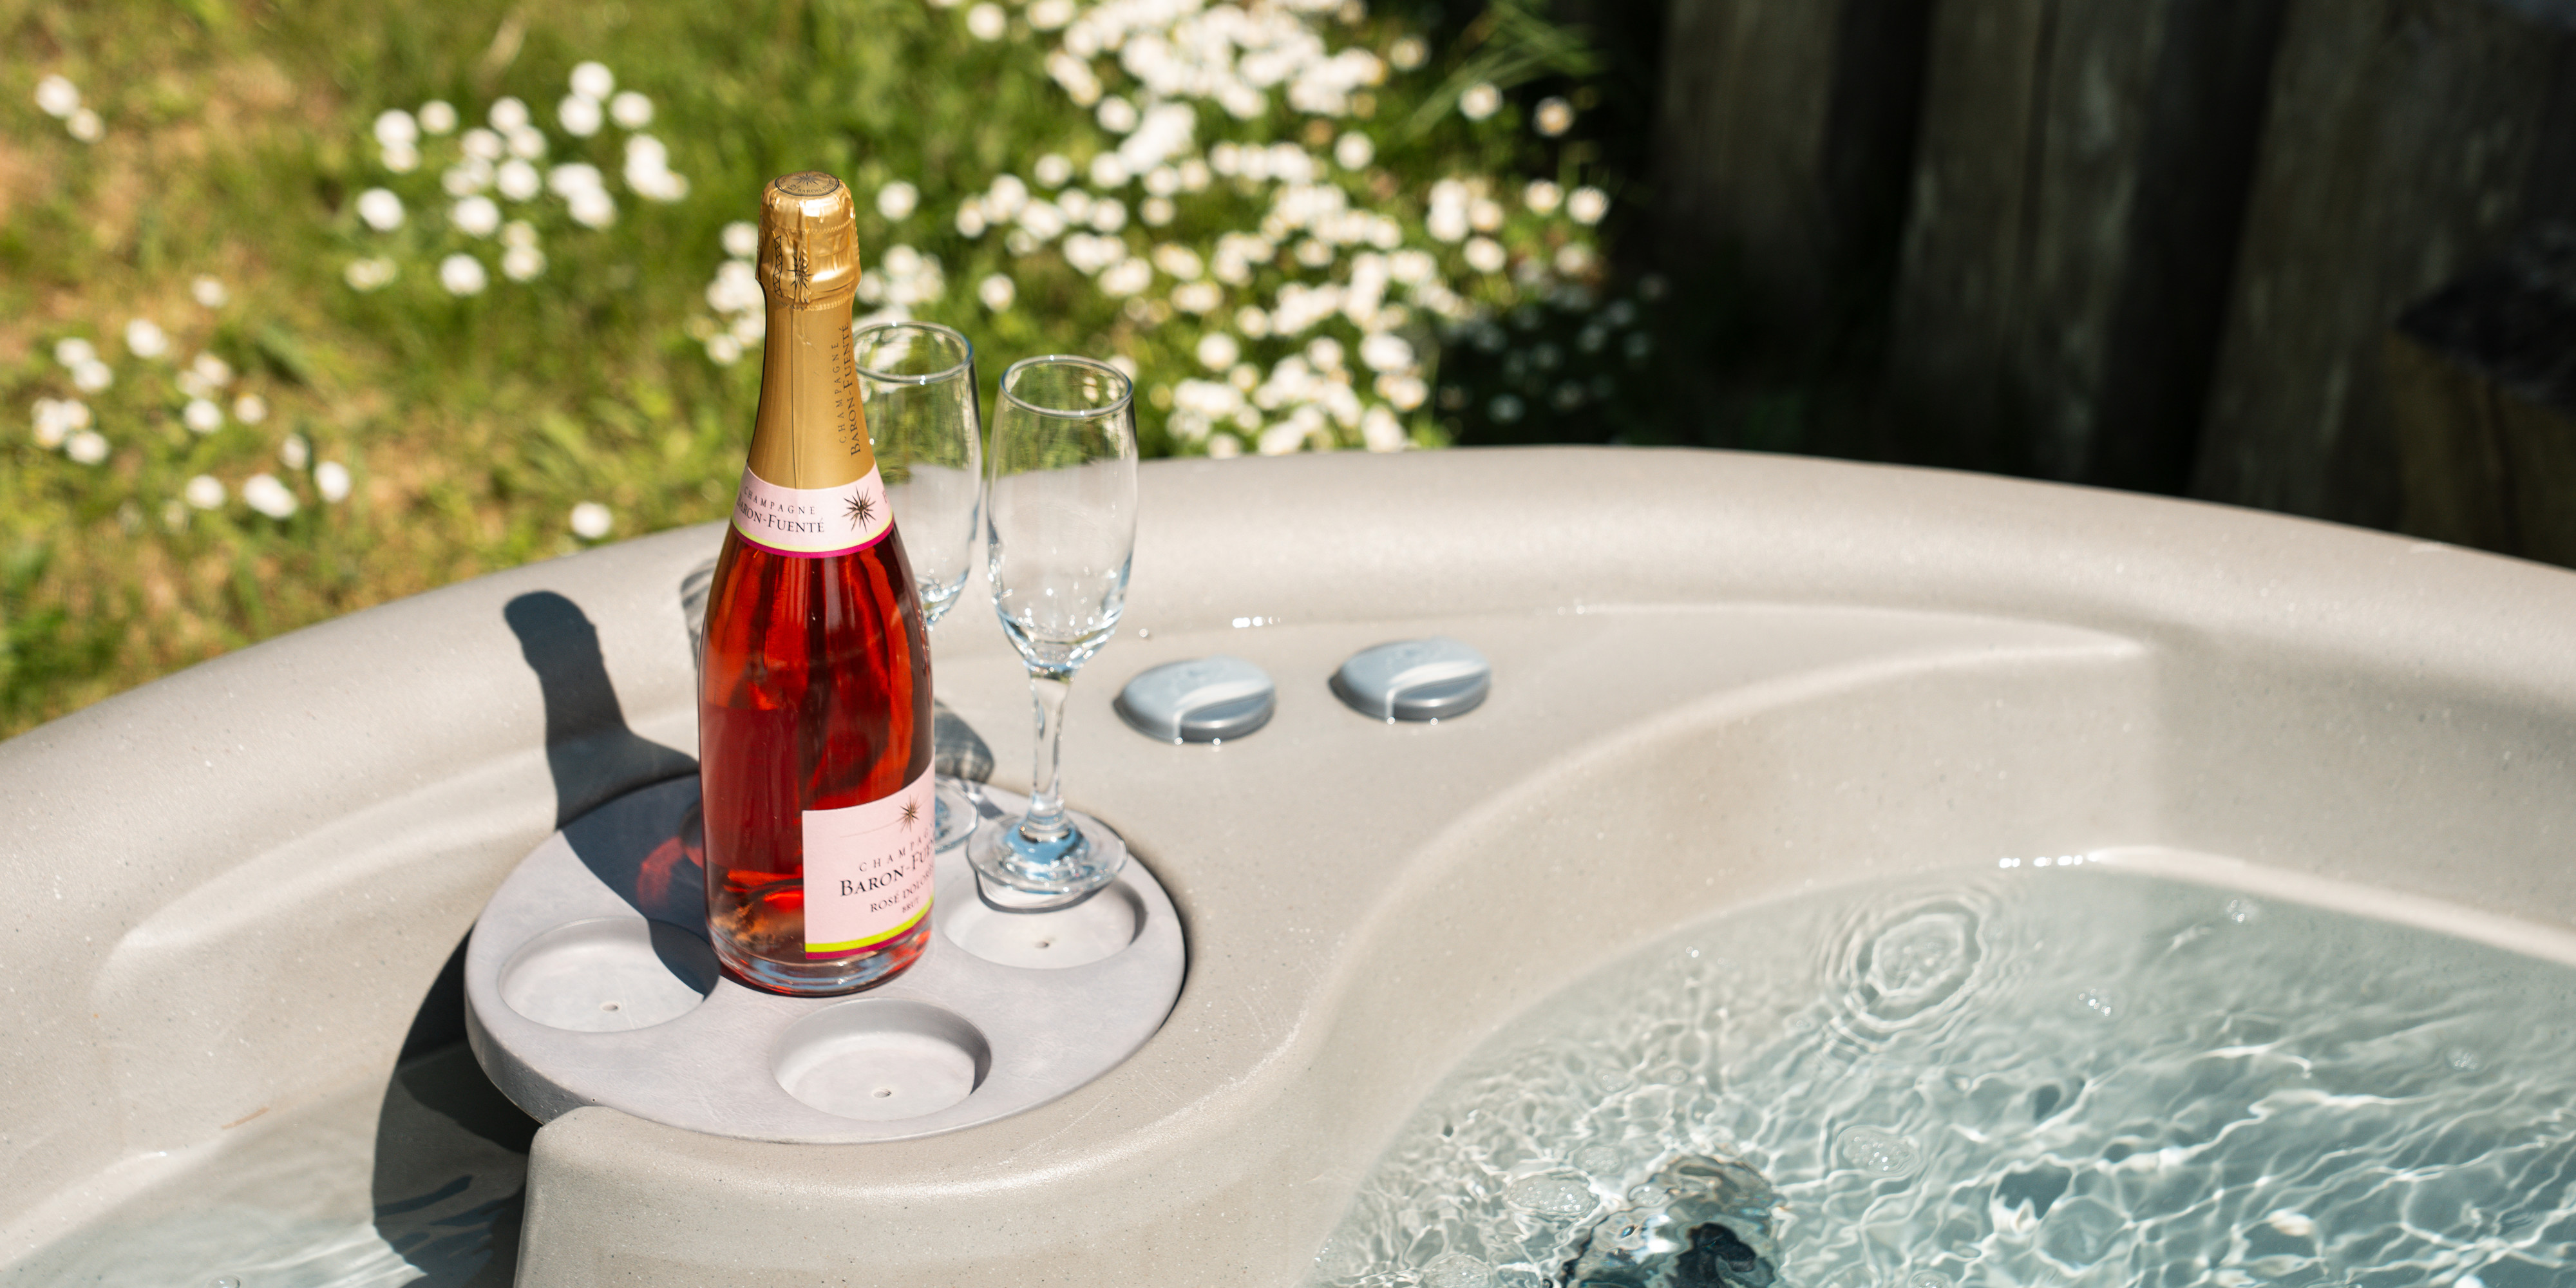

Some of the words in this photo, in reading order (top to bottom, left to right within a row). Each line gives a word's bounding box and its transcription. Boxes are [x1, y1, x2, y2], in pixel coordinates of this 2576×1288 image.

[831, 343, 847, 444] CHAMPAGNE
[838, 322, 861, 457] BARON-FUENTÉ
[743, 486, 816, 515] CHAMPAGNE
[859, 822, 934, 872] CHAMPAG
[870, 891, 900, 913] ROSÉ
[902, 896, 920, 913] BRUT
